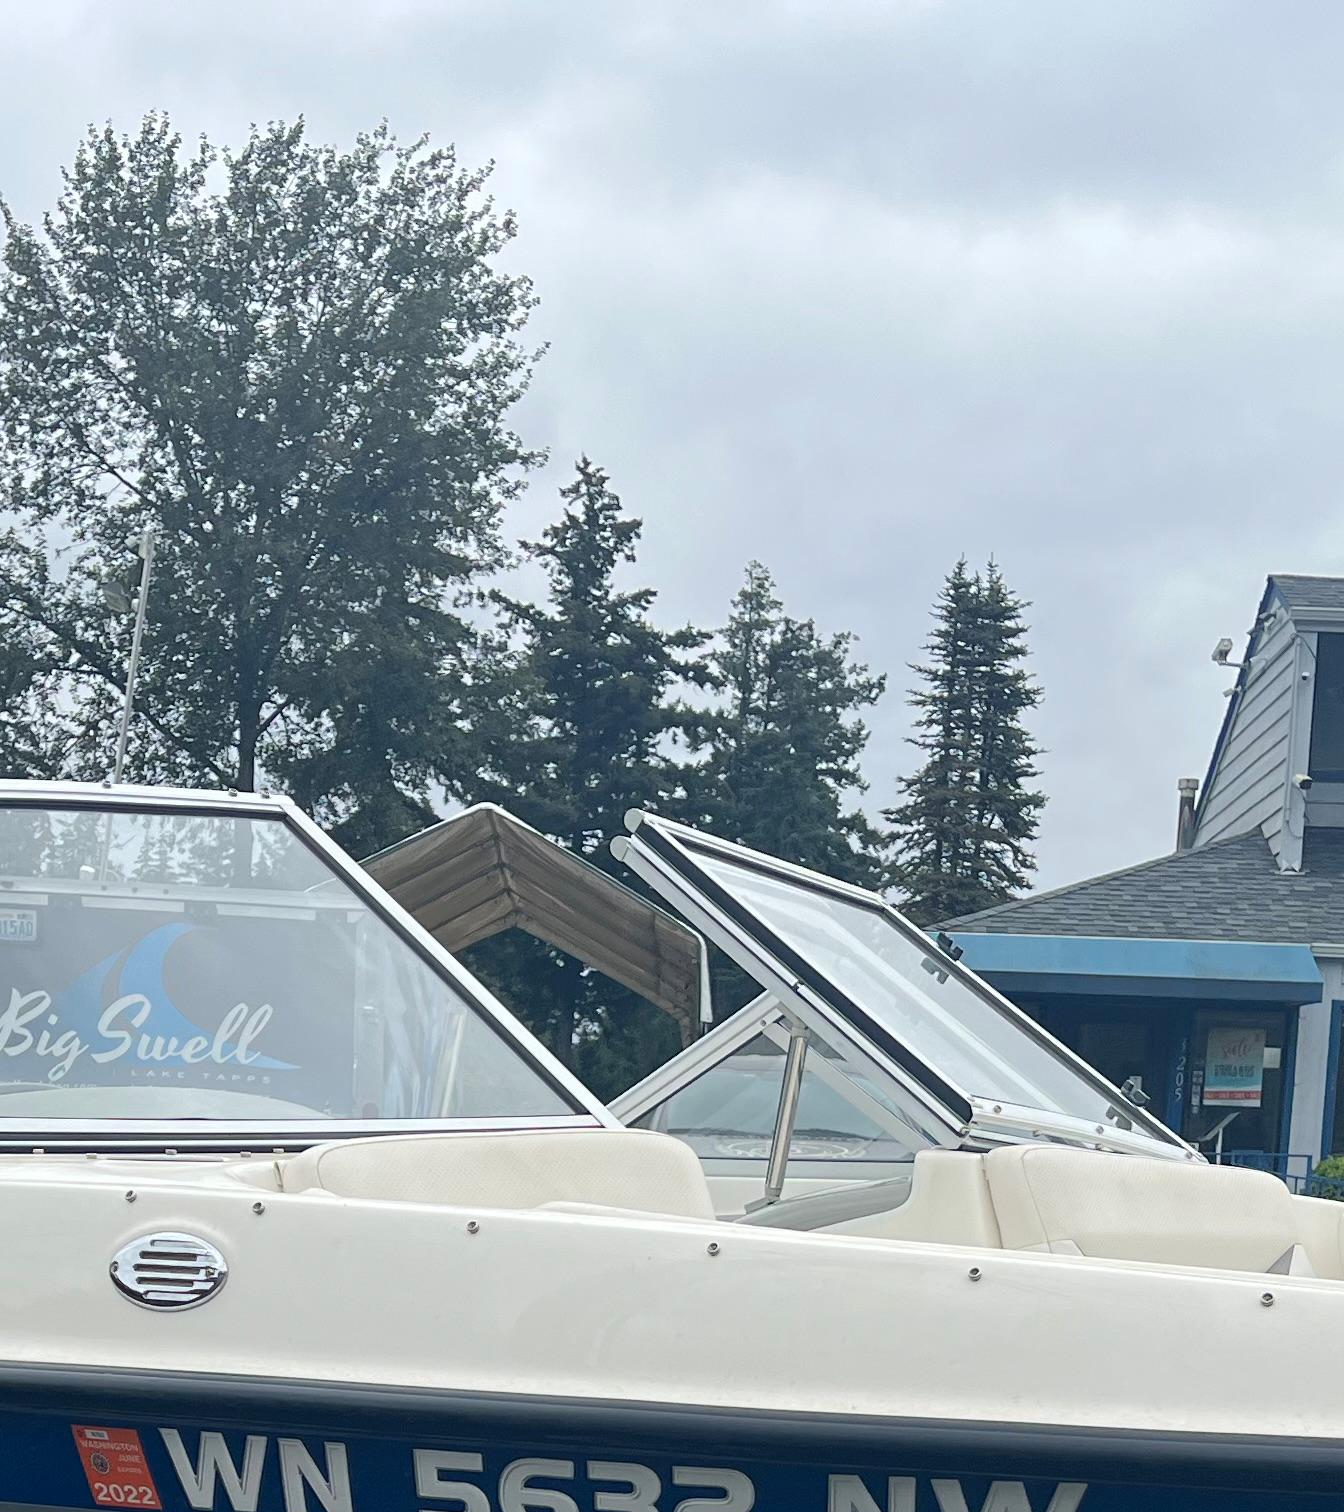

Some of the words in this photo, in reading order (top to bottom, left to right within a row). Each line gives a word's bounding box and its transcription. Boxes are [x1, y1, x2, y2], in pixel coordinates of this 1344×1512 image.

[91, 993, 274, 1065] Swell
[130, 1070, 186, 1079] LAKE
[203, 1072, 271, 1084] TAPPS
[94, 1482, 156, 1505] 2022
